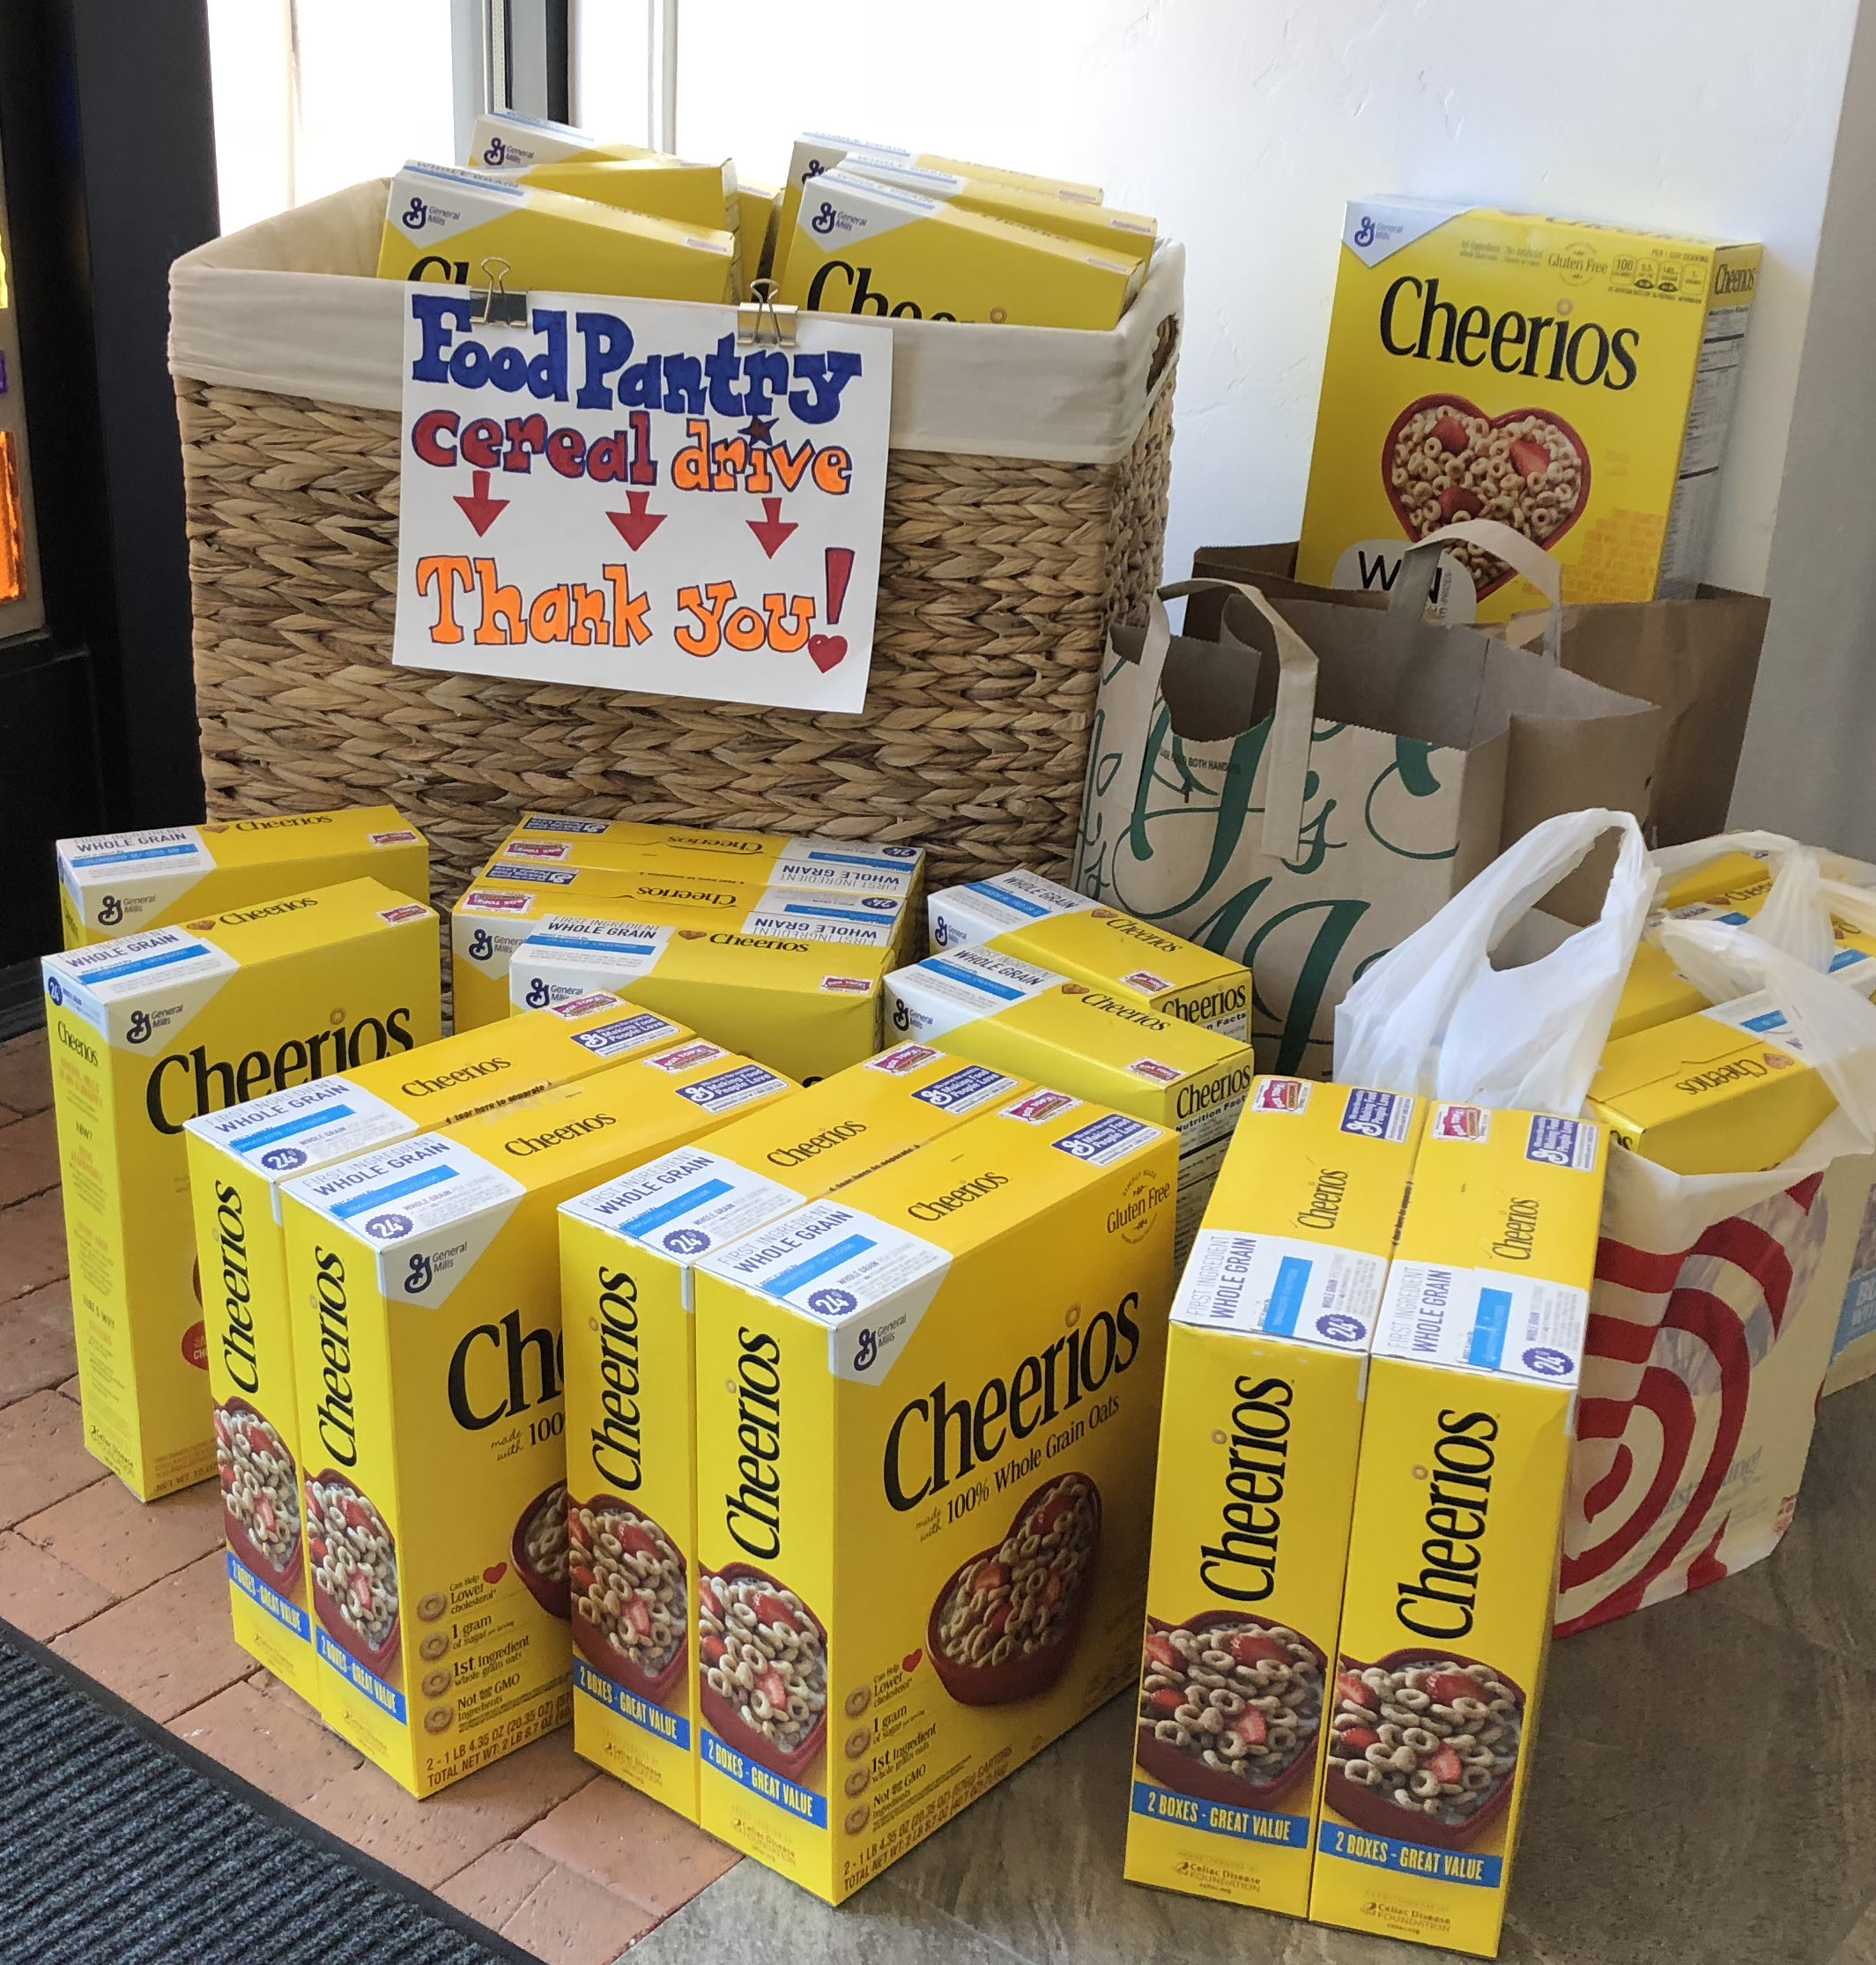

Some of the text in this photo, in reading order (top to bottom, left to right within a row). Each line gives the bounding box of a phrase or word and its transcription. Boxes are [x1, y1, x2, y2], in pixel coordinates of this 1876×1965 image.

[428, 205, 461, 222] General
[837, 211, 867, 226] General
[1547, 253, 1583, 271] Gluten
[1586, 258, 1608, 274] Free
[1617, 258, 1634, 271] 100
[1379, 275, 1642, 390] Cheerios
[412, 293, 863, 425] Food Pantry
[412, 409, 853, 495] cereal drive
[416, 555, 653, 648] Thank
[235, 814, 333, 832] Cheerios
[78, 832, 187, 853] WHOLE GRAIN
[668, 836, 763, 854] Cheerios
[782, 864, 900, 885] WHOLE GRAIN
[123, 894, 156, 908] General
[219, 896, 319, 925] Cheerios
[636, 886, 738, 908] Cheerios
[547, 922, 656, 940] WHOLE GRAIN
[709, 932, 810, 953] Cheerios
[754, 918, 878, 938] WHOLE GRAIN
[1106, 917, 1183, 953] Cheerios
[66, 933, 179, 968] WHOLE GRAIN
[494, 944, 513, 954] Mills
[954, 949, 1044, 986] WHOLE GRAIN
[551, 984, 583, 996] General
[151, 1005, 183, 1020] General
[1082, 992, 1171, 1033] Cheerios
[1217, 1012, 1247, 1028] Facts
[57, 1020, 99, 1068] Cheerios
[146, 1007, 413, 1135] Cheerios
[401, 1057, 512, 1098] Cheerios
[1675, 1058, 1768, 1095] Cheerios
[215, 1086, 350, 1133] WHOLE GRAIN
[474, 1102, 495, 1114] here
[1177, 1064, 1251, 1120] Cheerios
[504, 1111, 617, 1159] Cheerios
[1175, 1107, 1221, 1132] Nutrition
[766, 1119, 868, 1169] Cheerios
[314, 1144, 451, 1197] WHOLE GRAIN
[580, 1151, 693, 1208] FIRST INGREDIENT
[595, 1156, 716, 1216] WHOLE GRAIN
[907, 1170, 1010, 1223] Cheerios
[1107, 1182, 1171, 1235] Gluten Free
[1297, 1168, 1349, 1231] Cheerios
[718, 1205, 832, 1267] FIRST INGREDIENT
[733, 1210, 854, 1274] WHOLE GRAIN
[1492, 1197, 1540, 1262] Cheerios
[432, 1242, 468, 1263] General
[434, 1259, 454, 1273] Mills
[1197, 1235, 1230, 1288] INGREDIENT
[213, 1179, 259, 1395] Cheerios
[1209, 1237, 1257, 1319] WHOLE GRAIN
[1394, 1267, 1425, 1320] INGREDIENT
[1187, 1289, 1212, 1316] FIRST
[1412, 1270, 1452, 1353] WHOLE GRAIN
[877, 1313, 908, 1338] General
[879, 1331, 895, 1348] Mills
[1388, 1322, 1412, 1349] FIRST
[310, 1245, 358, 1467] Cheerios
[590, 1266, 641, 1492] Cheerios
[884, 1291, 1140, 1513] Cheerios
[491, 1428, 523, 1450] made
[496, 1440, 523, 1461] with
[725, 1325, 781, 1561] Cheerios
[946, 1394, 1121, 1524] 100% Whole Grain Oats
[1200, 1376, 1294, 1602] Cheerios
[916, 1505, 942, 1531] made
[920, 1519, 942, 1542] with
[1396, 1409, 1499, 1640] Cheerios
[450, 1583, 484, 1605] Lower
[463, 1615, 492, 1638] gram
[463, 1632, 486, 1647] sugar
[454, 1635, 530, 1677] 1st Ingredient
[482, 1661, 503, 1678] grain
[457, 1673, 521, 1710] Not GMO
[458, 1695, 503, 1722] Ingredients
[587, 1672, 678, 1740] BOXES GREAT VALUE
[426, 1758, 434, 1771] 2
[454, 1744, 466, 1759] LB
[492, 1724, 505, 1741] OZ
[428, 1731, 523, 1787] TOTAL NET LB
[708, 1739, 814, 1817] 2 BOXES GREAT VALUE
[873, 1763, 927, 1807] Not GMO
[1147, 1792, 1291, 1842] 2 BOXES GREAT VALUE
[1190, 1863, 1261, 1885] Celiac Disease
[1337, 1832, 1484, 1882] 2 BOXES GREAT VALUE
[844, 1867, 871, 1892] TOTAL
[1190, 1870, 1261, 1893] FOUNDATION
[1376, 1910, 1451, 1933] FOUNDATION
[1377, 1902, 1452, 1924] Celiac Disease
